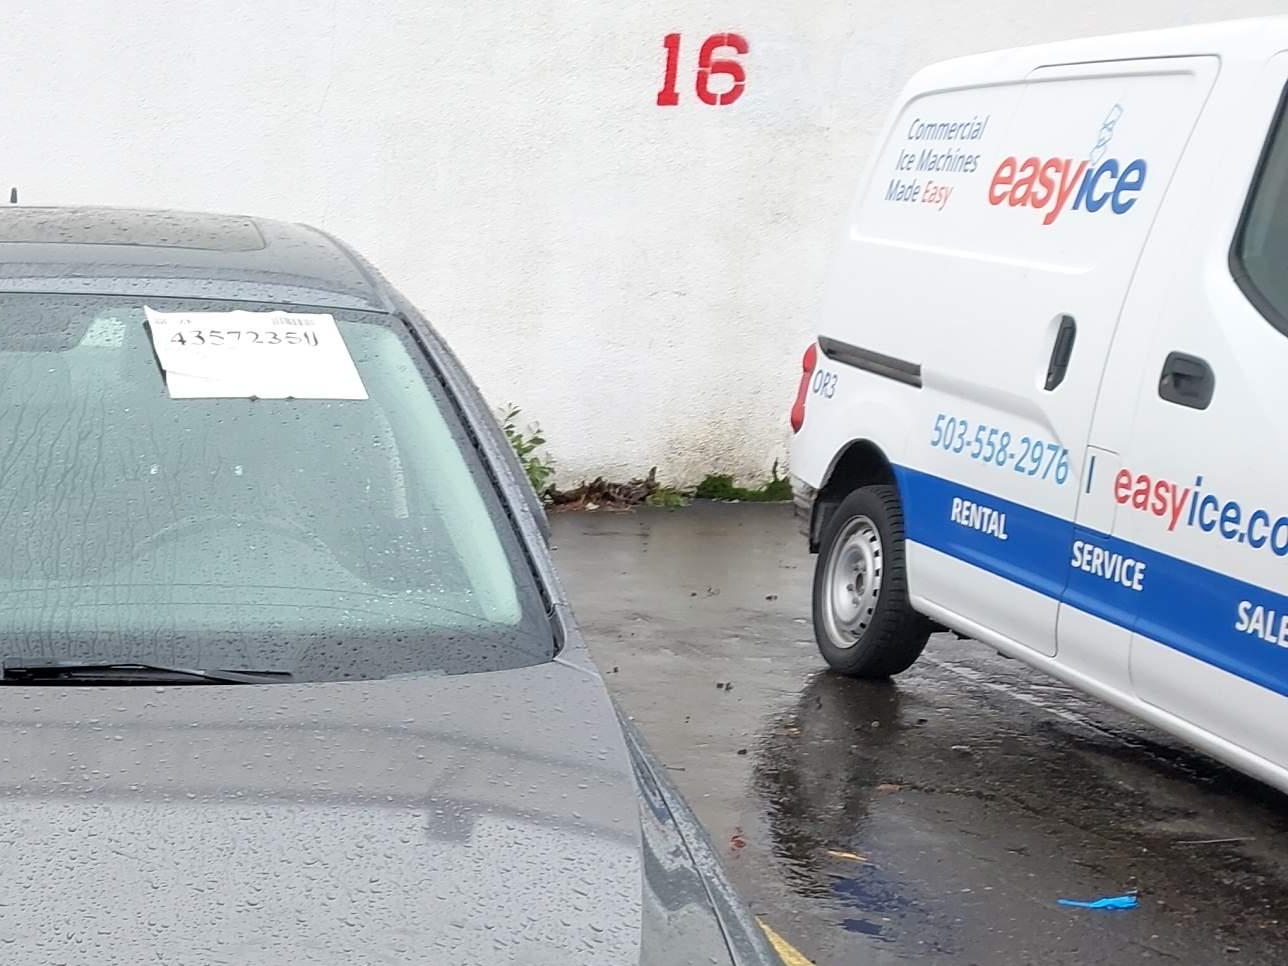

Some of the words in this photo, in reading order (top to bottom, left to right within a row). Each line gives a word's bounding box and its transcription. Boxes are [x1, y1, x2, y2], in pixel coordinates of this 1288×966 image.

[656, 33, 750, 107] 16
[908, 116, 989, 141] Commercial
[895, 149, 916, 172] Ice
[917, 149, 981, 174] Machines
[885, 179, 921, 202] Made
[920, 181, 954, 211] Easy
[988, 156, 1148, 226] easyice
[930, 414, 1070, 485] 503-558-2976
[951, 497, 1009, 540] RENTAL
[1071, 540, 1146, 592] SERVICE
